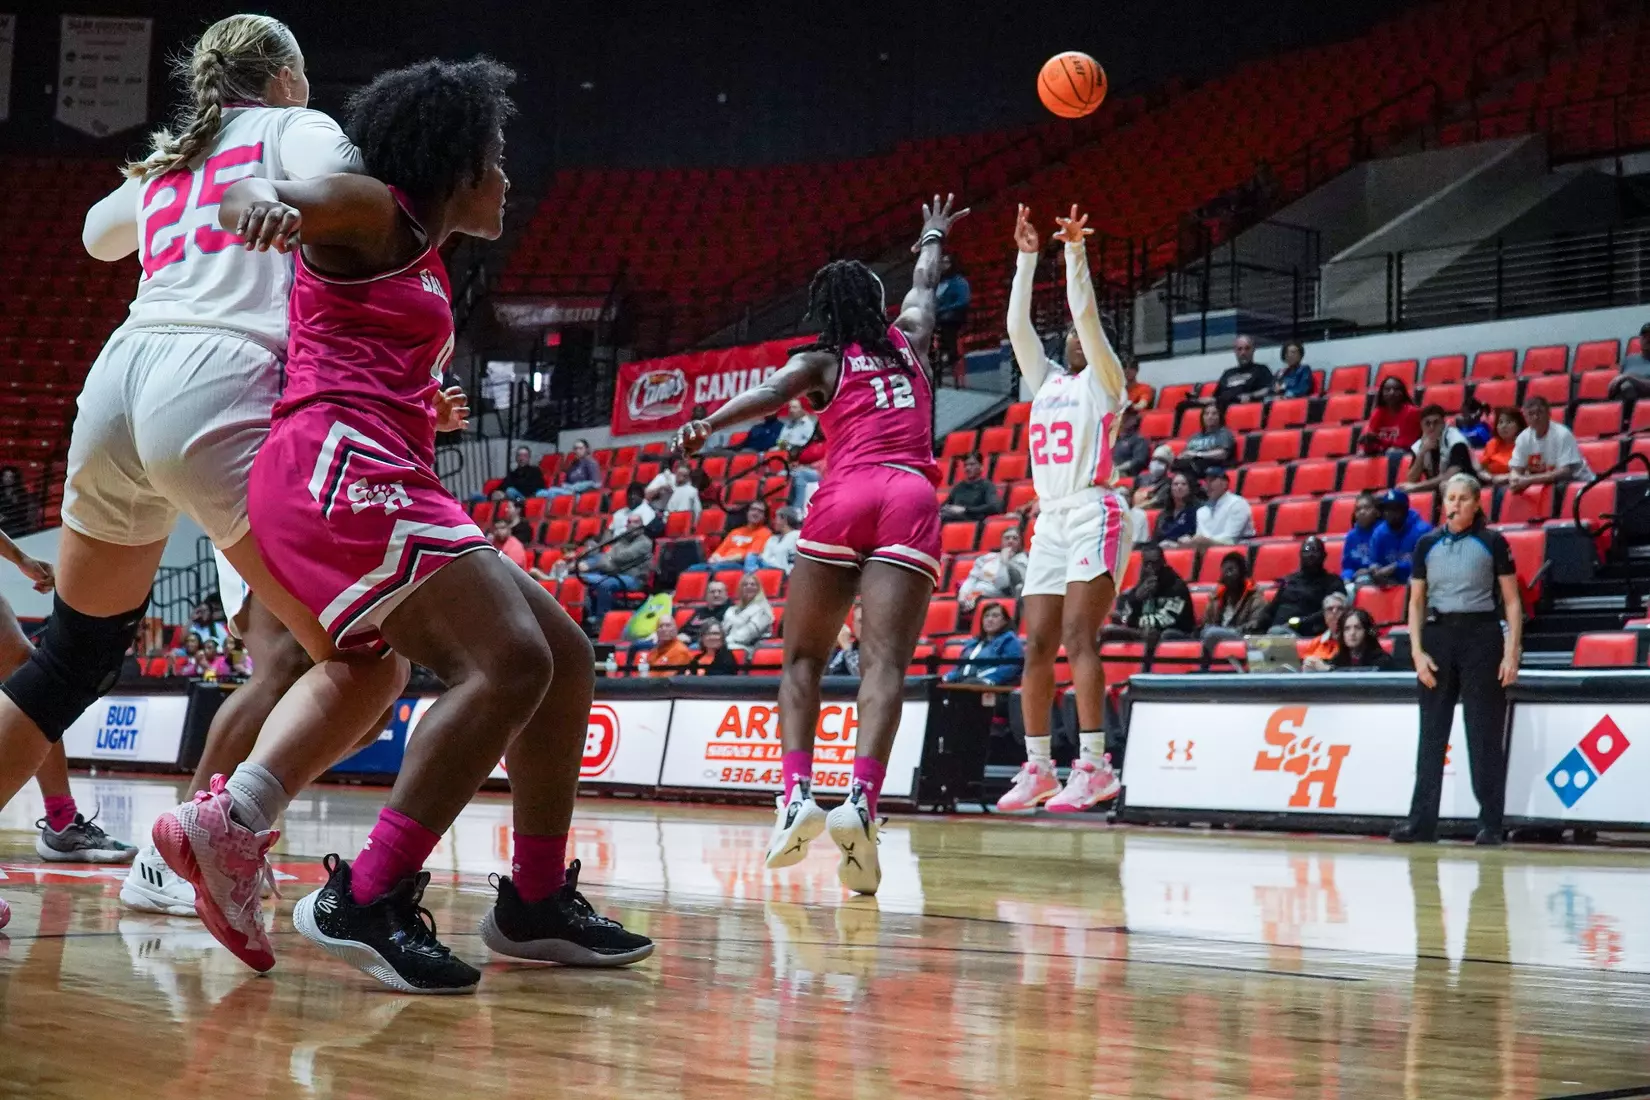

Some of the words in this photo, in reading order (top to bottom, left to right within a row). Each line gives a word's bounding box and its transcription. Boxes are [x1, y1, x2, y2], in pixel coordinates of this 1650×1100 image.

[142, 141, 264, 281] 25
[869, 374, 916, 409] 12
[1030, 421, 1074, 466] 23
[106, 705, 137, 726] BUD
[716, 705, 860, 741] ARTCH
[96, 728, 139, 750] LIGHT
[1253, 705, 1351, 808] SH
